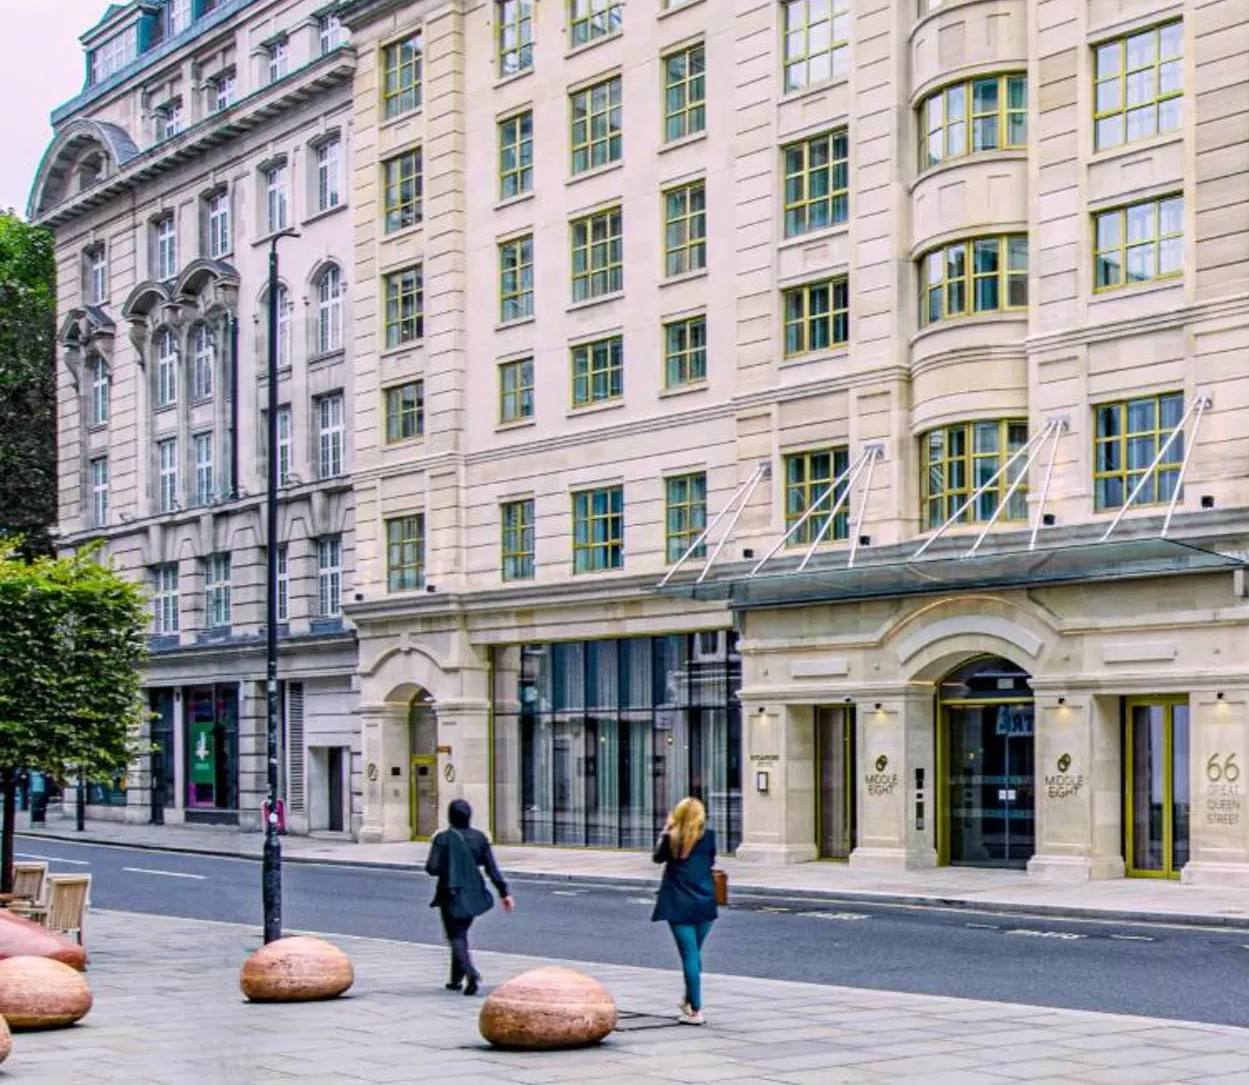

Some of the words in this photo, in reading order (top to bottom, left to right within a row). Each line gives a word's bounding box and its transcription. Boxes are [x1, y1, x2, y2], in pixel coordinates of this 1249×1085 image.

[1206, 752, 1240, 782] 66
[865, 773, 898, 784] MIDDLE
[1044, 774, 1083, 786] MIDDLE
[868, 785, 893, 796] EIGHT
[1048, 786, 1079, 798] EIGHT
[1207, 798, 1240, 810] QUEEN
[1207, 812, 1239, 824] STREET
